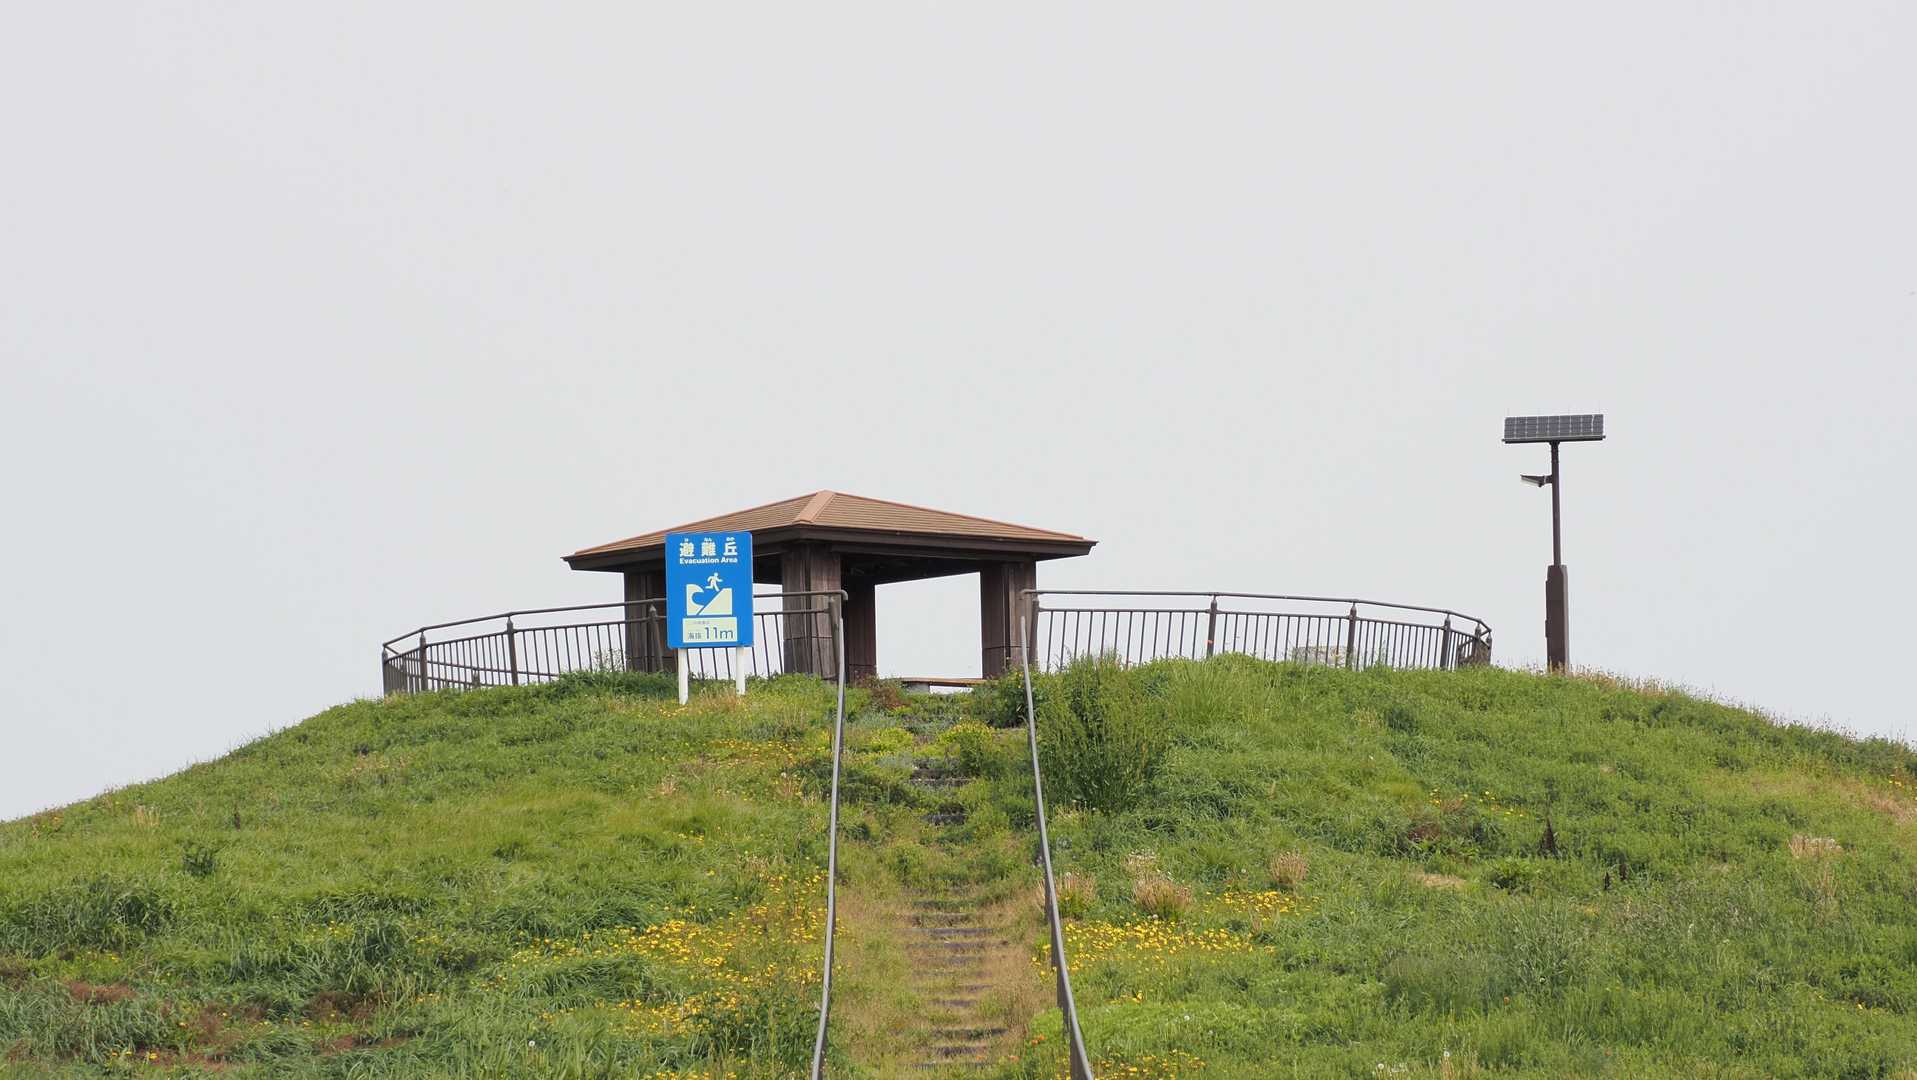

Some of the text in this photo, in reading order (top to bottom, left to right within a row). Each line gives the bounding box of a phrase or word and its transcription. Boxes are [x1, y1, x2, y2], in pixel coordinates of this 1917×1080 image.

[680, 541, 738, 557] 避難丘
[705, 627, 733, 639] 11m
